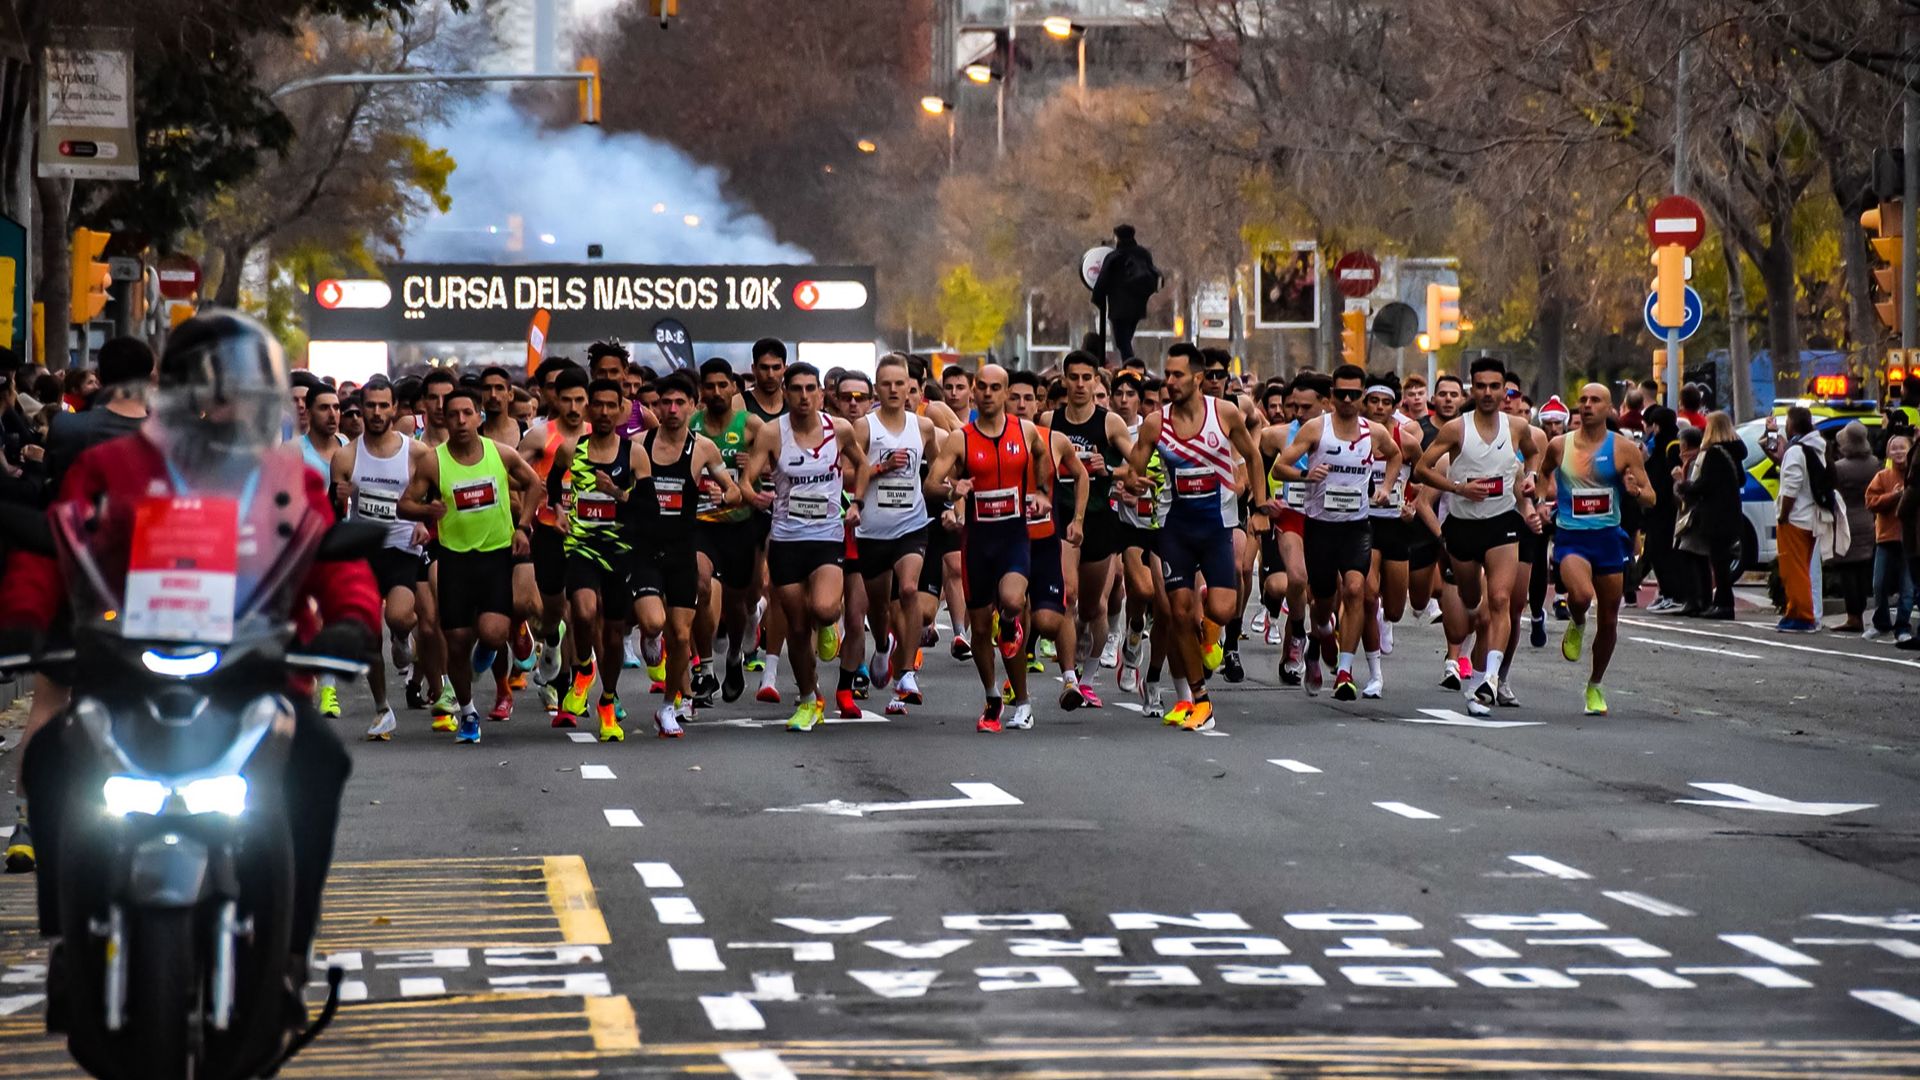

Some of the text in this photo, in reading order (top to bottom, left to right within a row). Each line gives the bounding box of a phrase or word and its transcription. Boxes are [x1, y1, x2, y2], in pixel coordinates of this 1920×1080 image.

[403, 276, 781, 310] CURSA DELS NASSOS 10K
[360, 476, 400, 485] SALOMON
[364, 502, 391, 516] 11843
[586, 507, 603, 518] 241
[773, 912, 1608, 935] RONDA
[730, 937, 1673, 961] LITORAL
